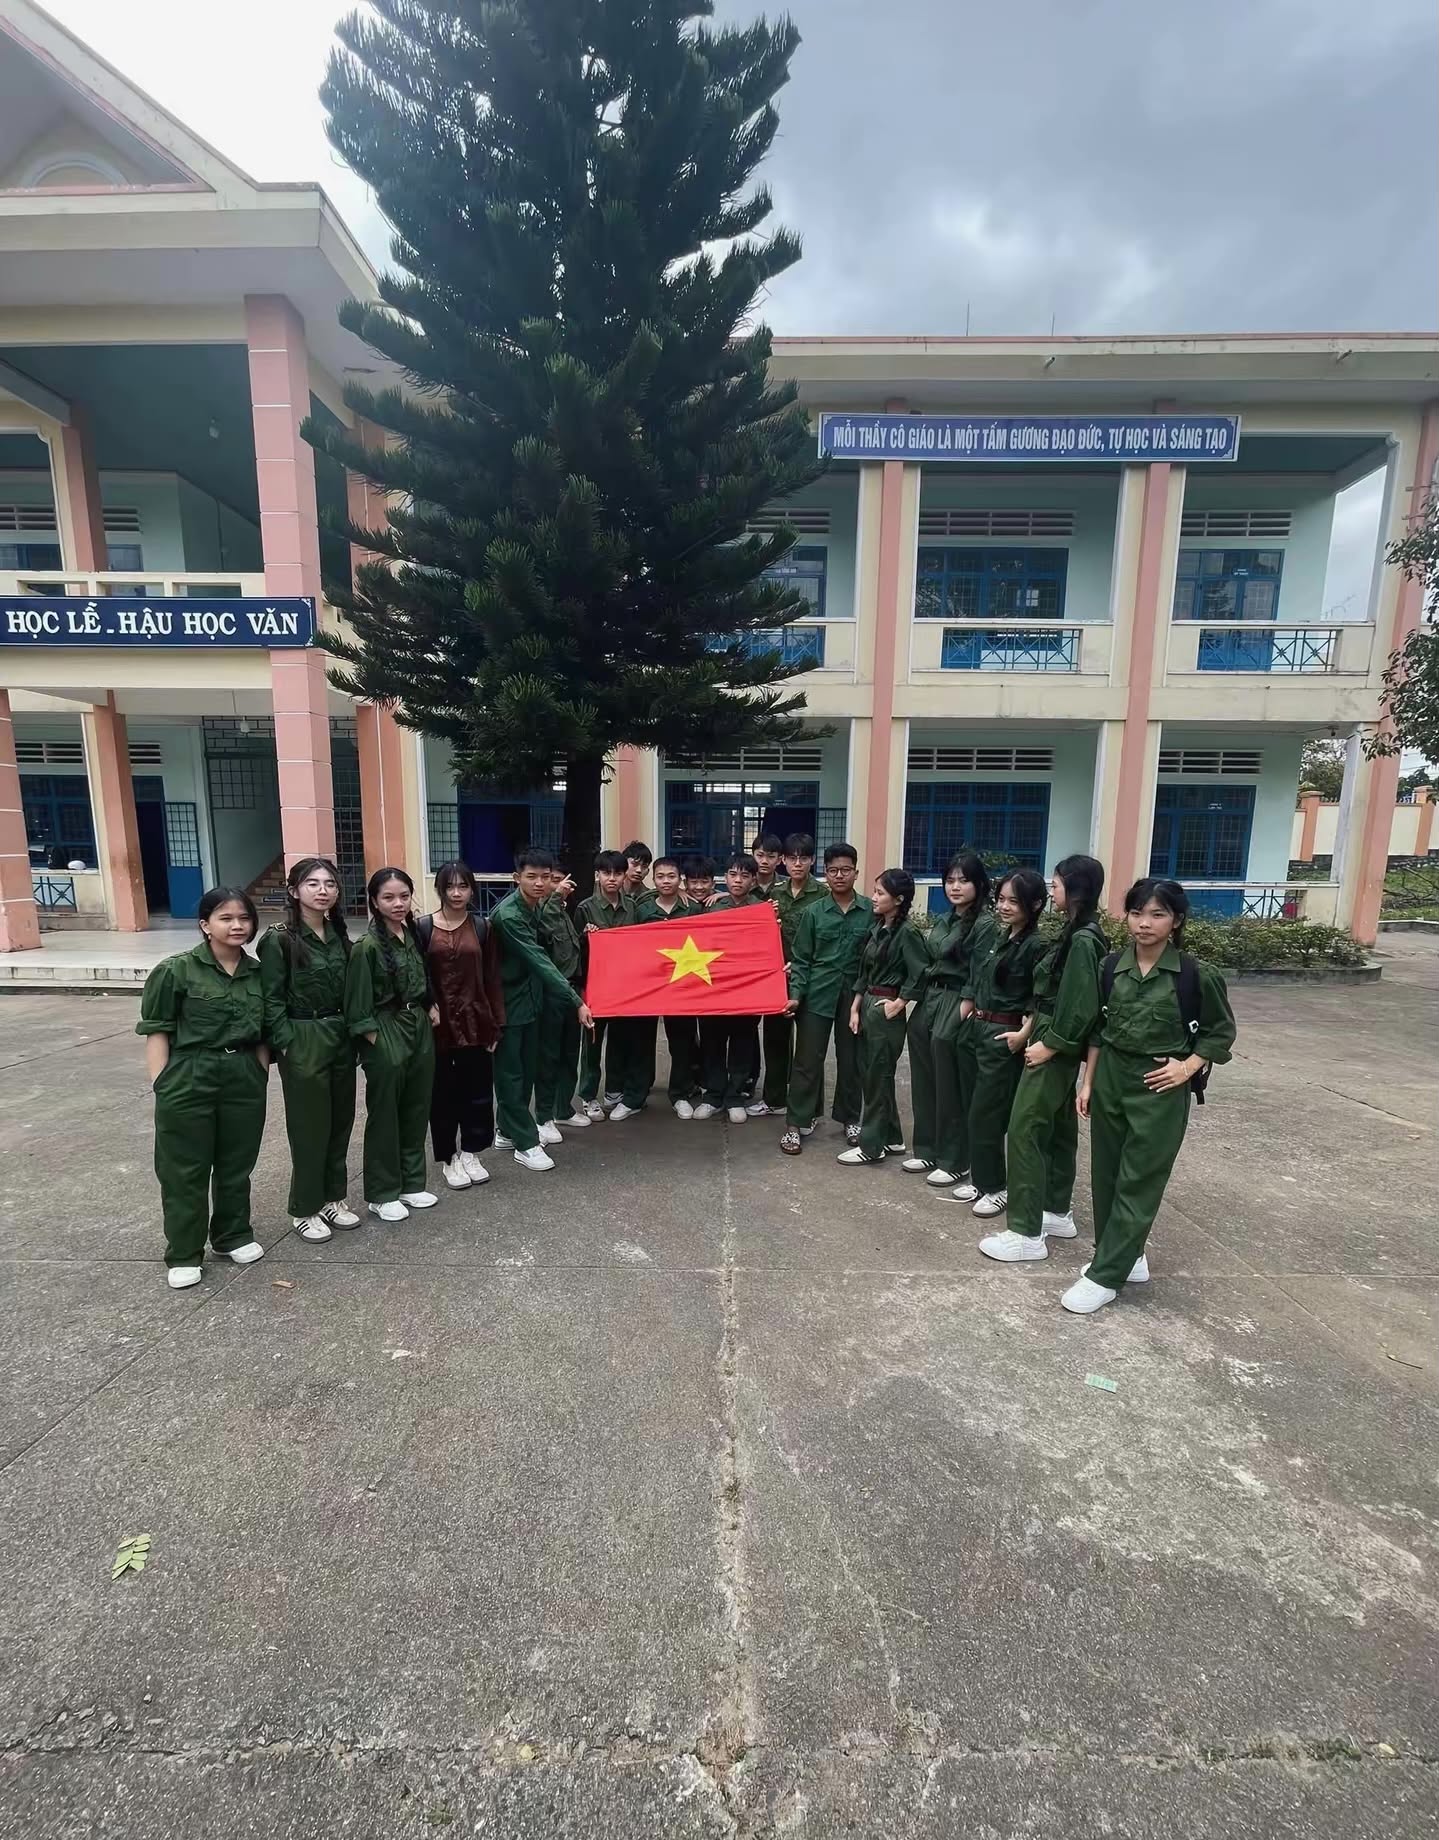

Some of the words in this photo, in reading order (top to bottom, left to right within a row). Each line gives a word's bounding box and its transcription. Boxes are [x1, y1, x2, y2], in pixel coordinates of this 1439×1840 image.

[833, 420, 855, 448] MỖI
[859, 420, 887, 448] THẦY
[890, 424, 904, 449] CÔ
[908, 424, 934, 449] GIÁO
[938, 424, 951, 449] LÀ
[955, 425, 979, 454] MỘT
[982, 421, 1007, 450] TẤM
[1010, 427, 1049, 450] GƯƠNG
[1109, 426, 1124, 454] TỰ
[1125, 428, 1149, 454] HỌC
[1152, 424, 1166, 449] VÀ
[1170, 424, 1202, 449] SÁNG
[1205, 428, 1227, 454] TẠO
[5, 610, 60, 639] HỌC
[68, 601, 101, 634] LỄ
[118, 607, 172, 639] HẬU
[182, 612, 236, 640] HỌC
[246, 608, 299, 636] VĂN
